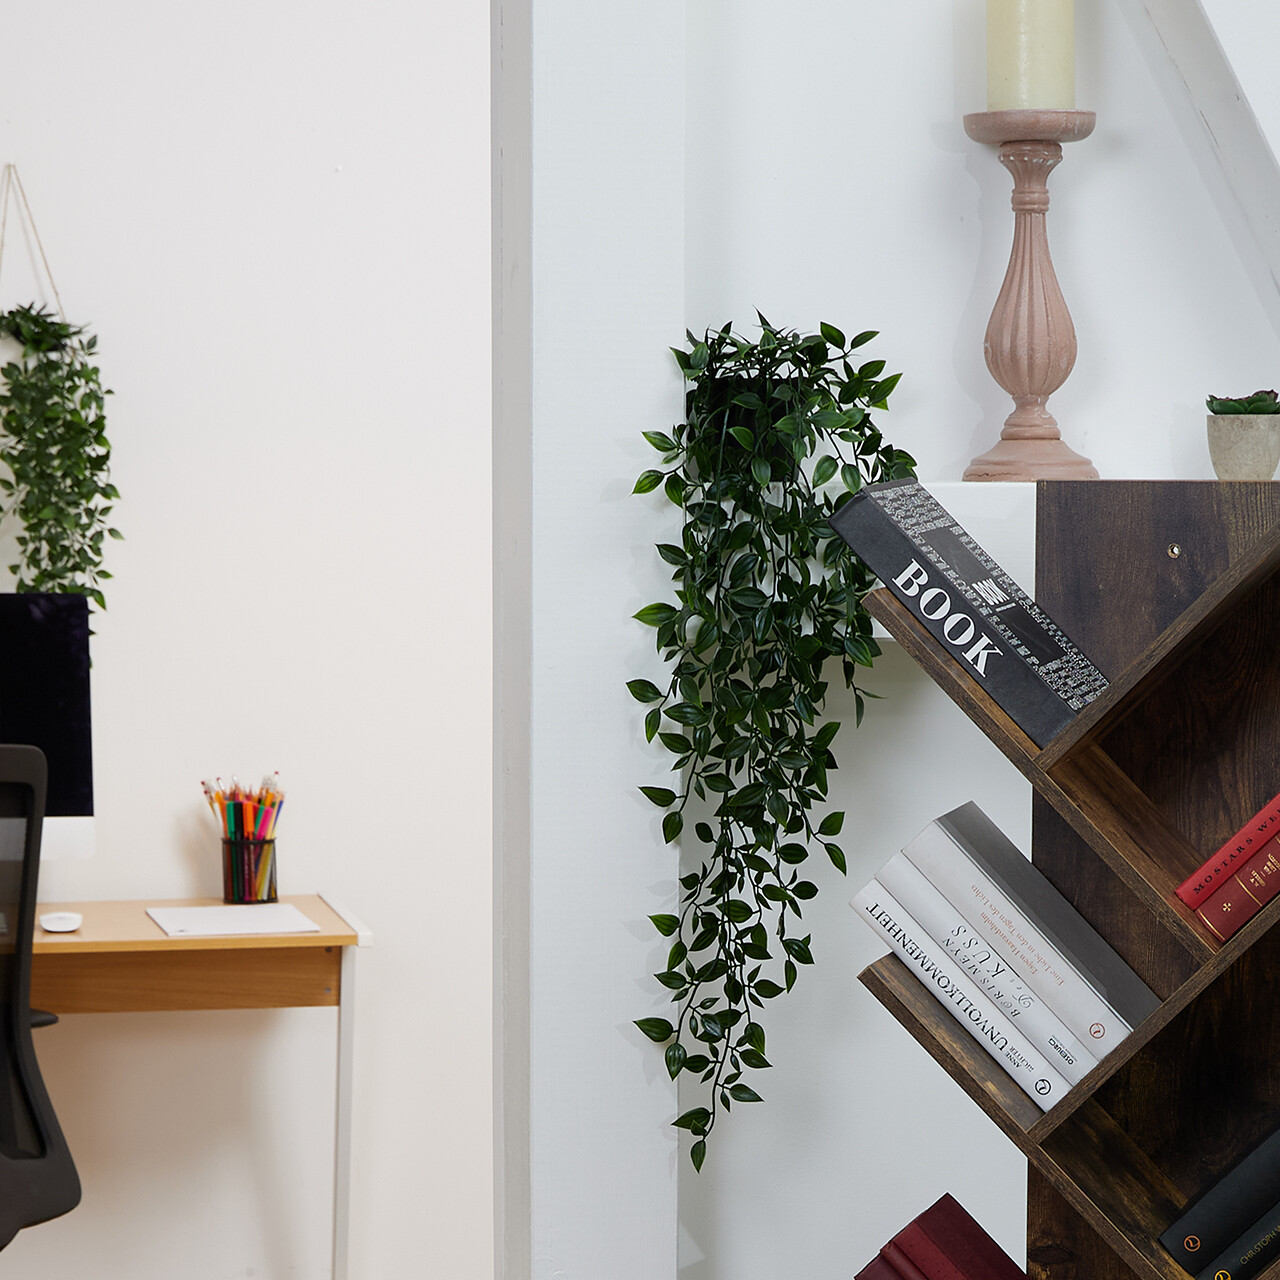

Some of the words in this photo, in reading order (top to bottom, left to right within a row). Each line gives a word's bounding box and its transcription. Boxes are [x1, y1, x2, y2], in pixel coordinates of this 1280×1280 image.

[892, 558, 1004, 677] BOOK
[971, 578, 1010, 606] BOOK
[1193, 836, 1253, 895] MOSTARS
[865, 902, 1009, 1051] UNVOLLKOMMENHEIT
[941, 937, 980, 976] MEYN
[951, 924, 1006, 979] KUSS
